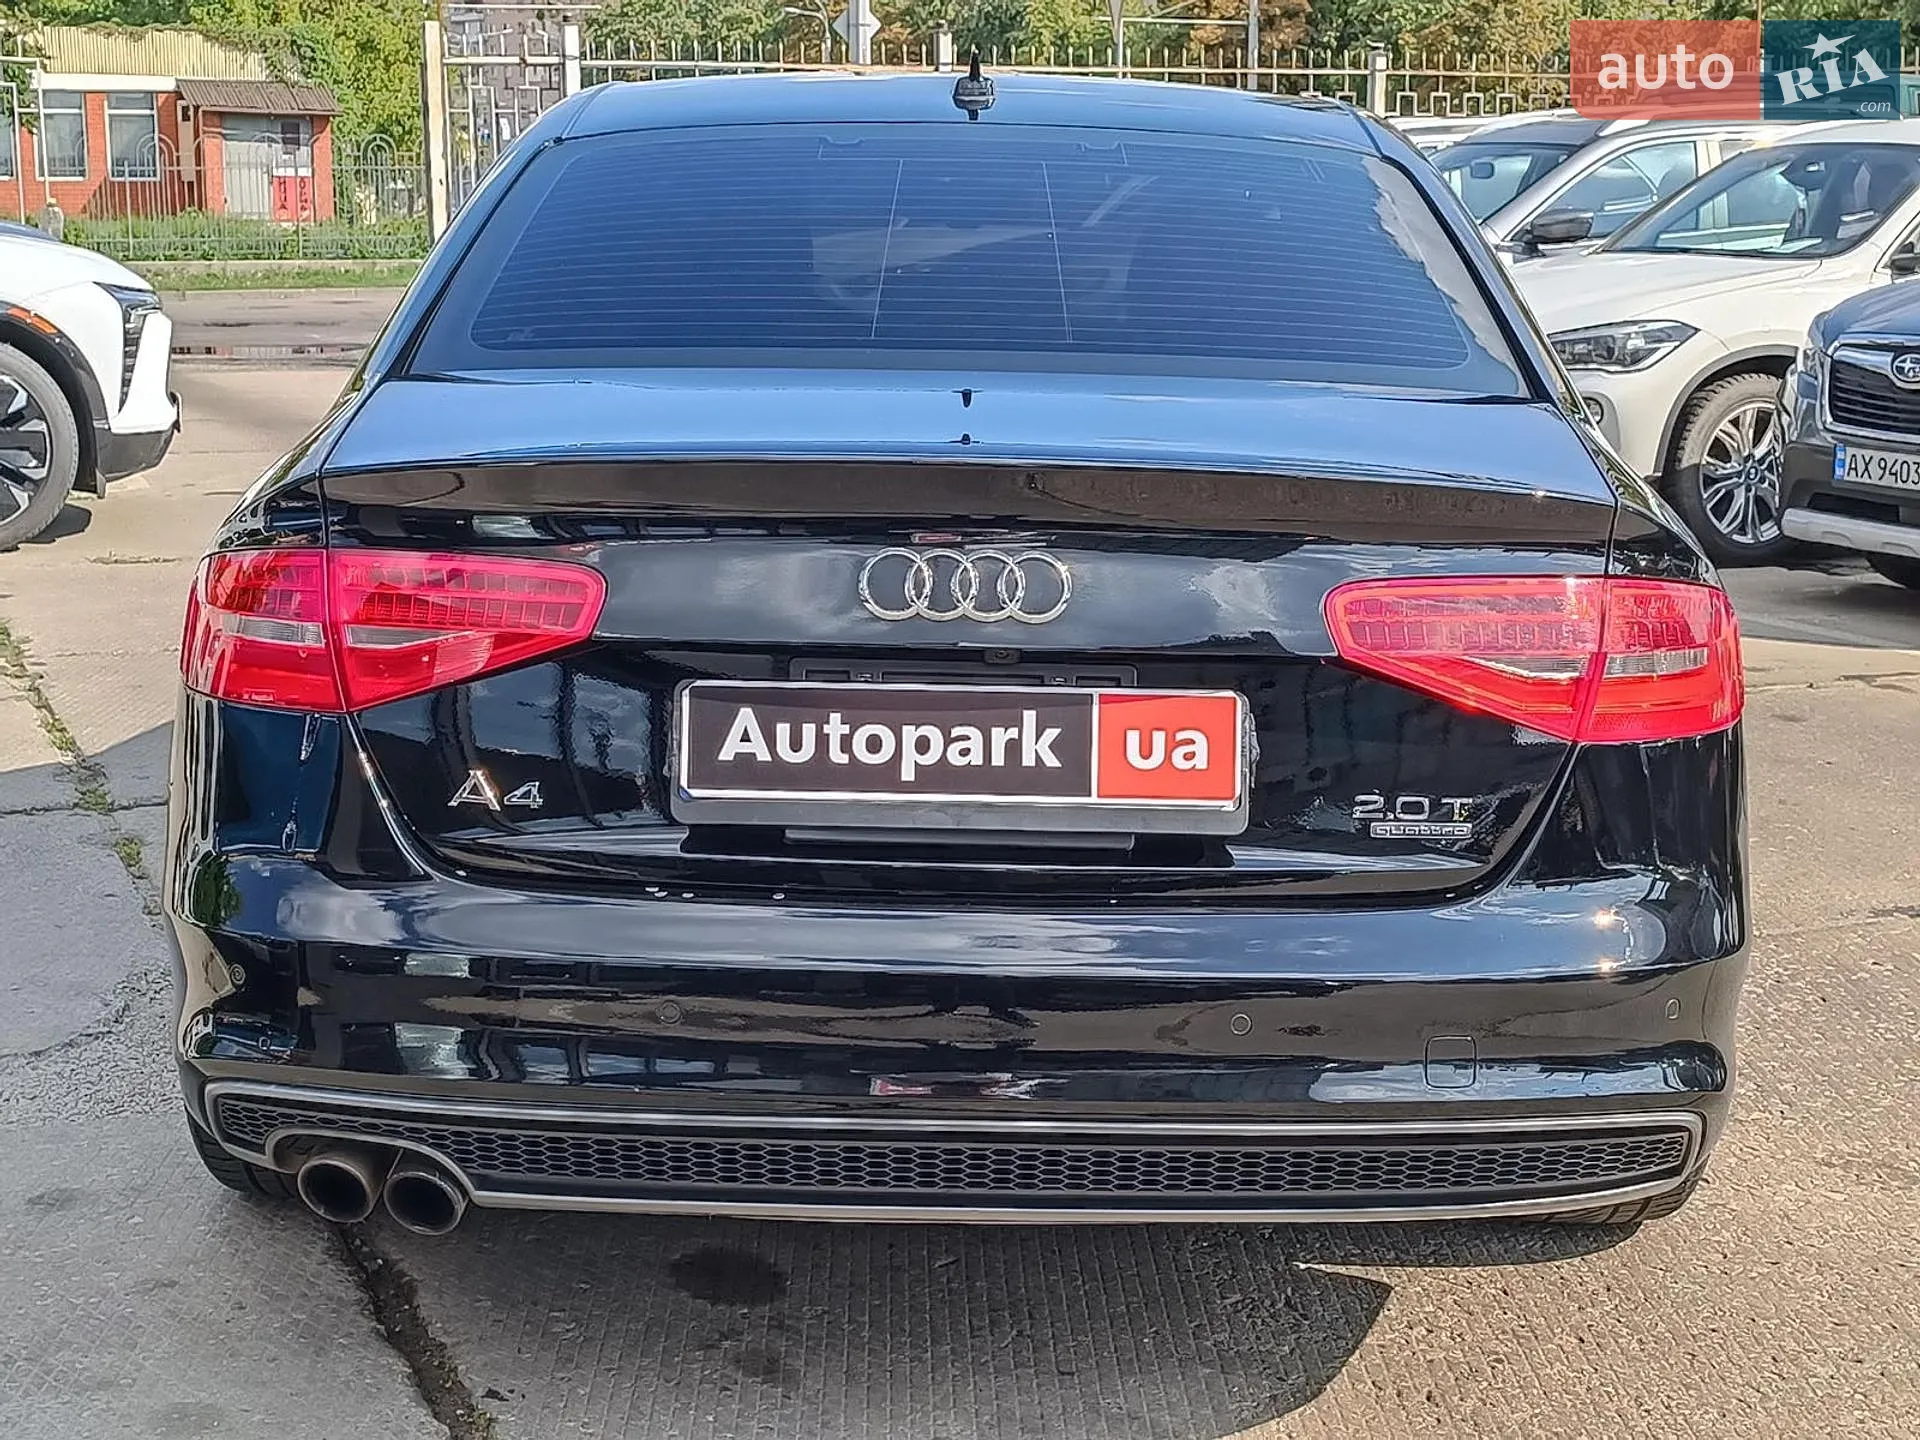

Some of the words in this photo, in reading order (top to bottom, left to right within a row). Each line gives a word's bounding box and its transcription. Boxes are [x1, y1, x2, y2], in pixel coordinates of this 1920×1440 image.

[1847, 453, 1873, 480] AX
[1877, 457, 1920, 485] 9403
[717, 706, 1063, 782] Autopark
[1124, 727, 1210, 771] ua
[447, 770, 543, 811] A4
[1373, 825, 1470, 837] quattro
